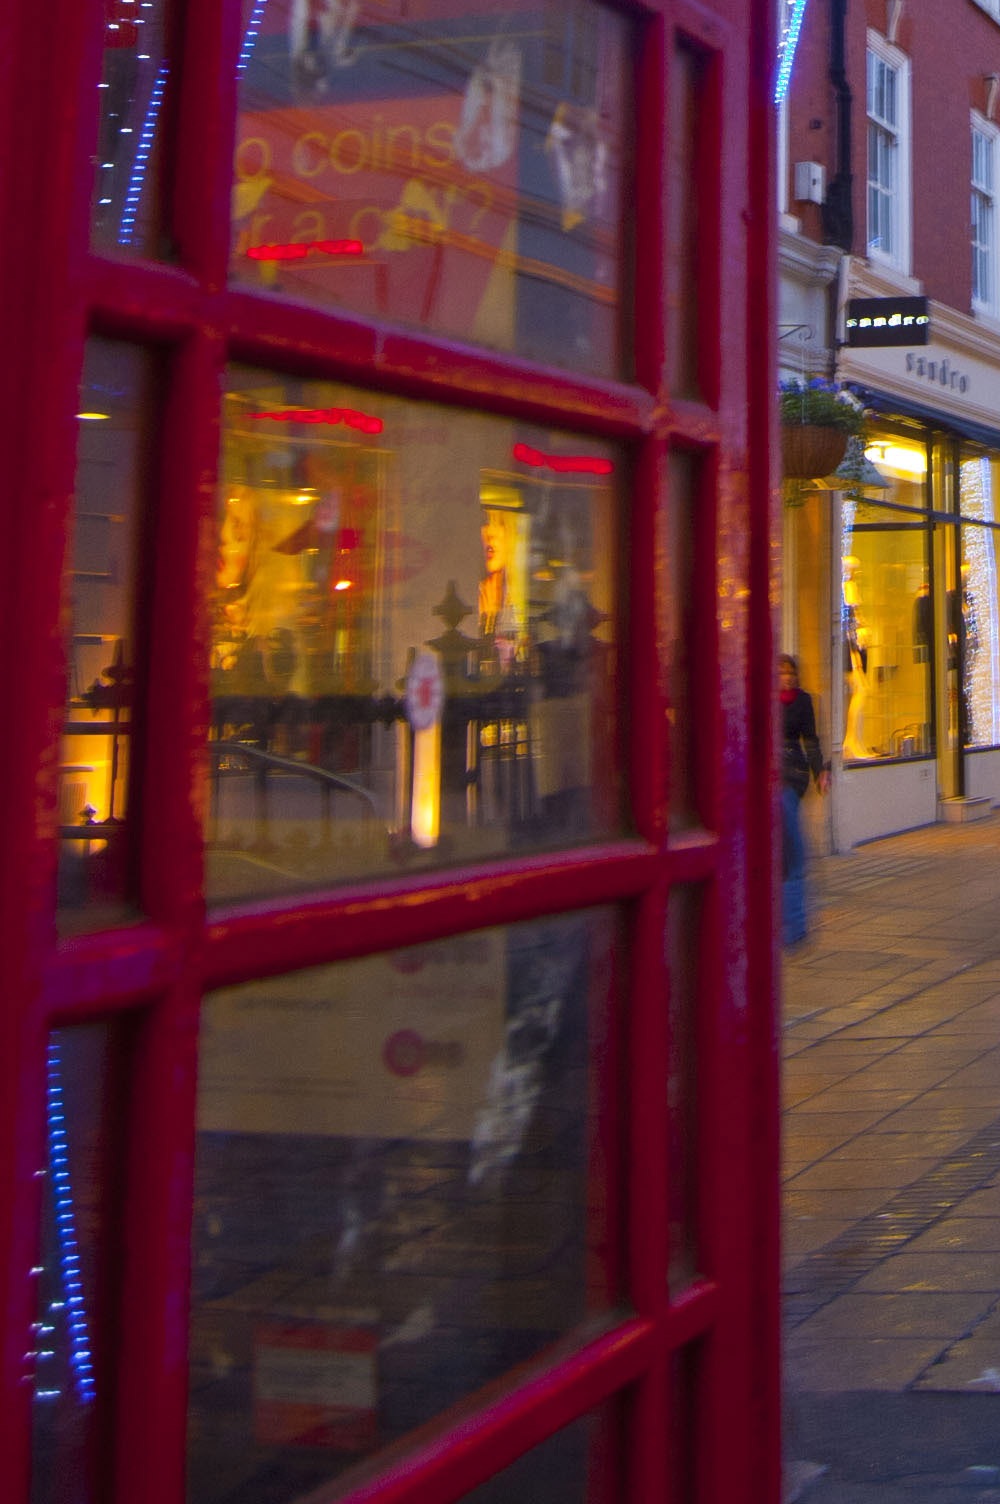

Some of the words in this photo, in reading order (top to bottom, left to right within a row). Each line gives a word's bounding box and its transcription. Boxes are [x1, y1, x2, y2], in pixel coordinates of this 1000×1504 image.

[292, 113, 458, 177] coins
[846, 313, 929, 328] sandro
[906, 353, 970, 393] sandro
